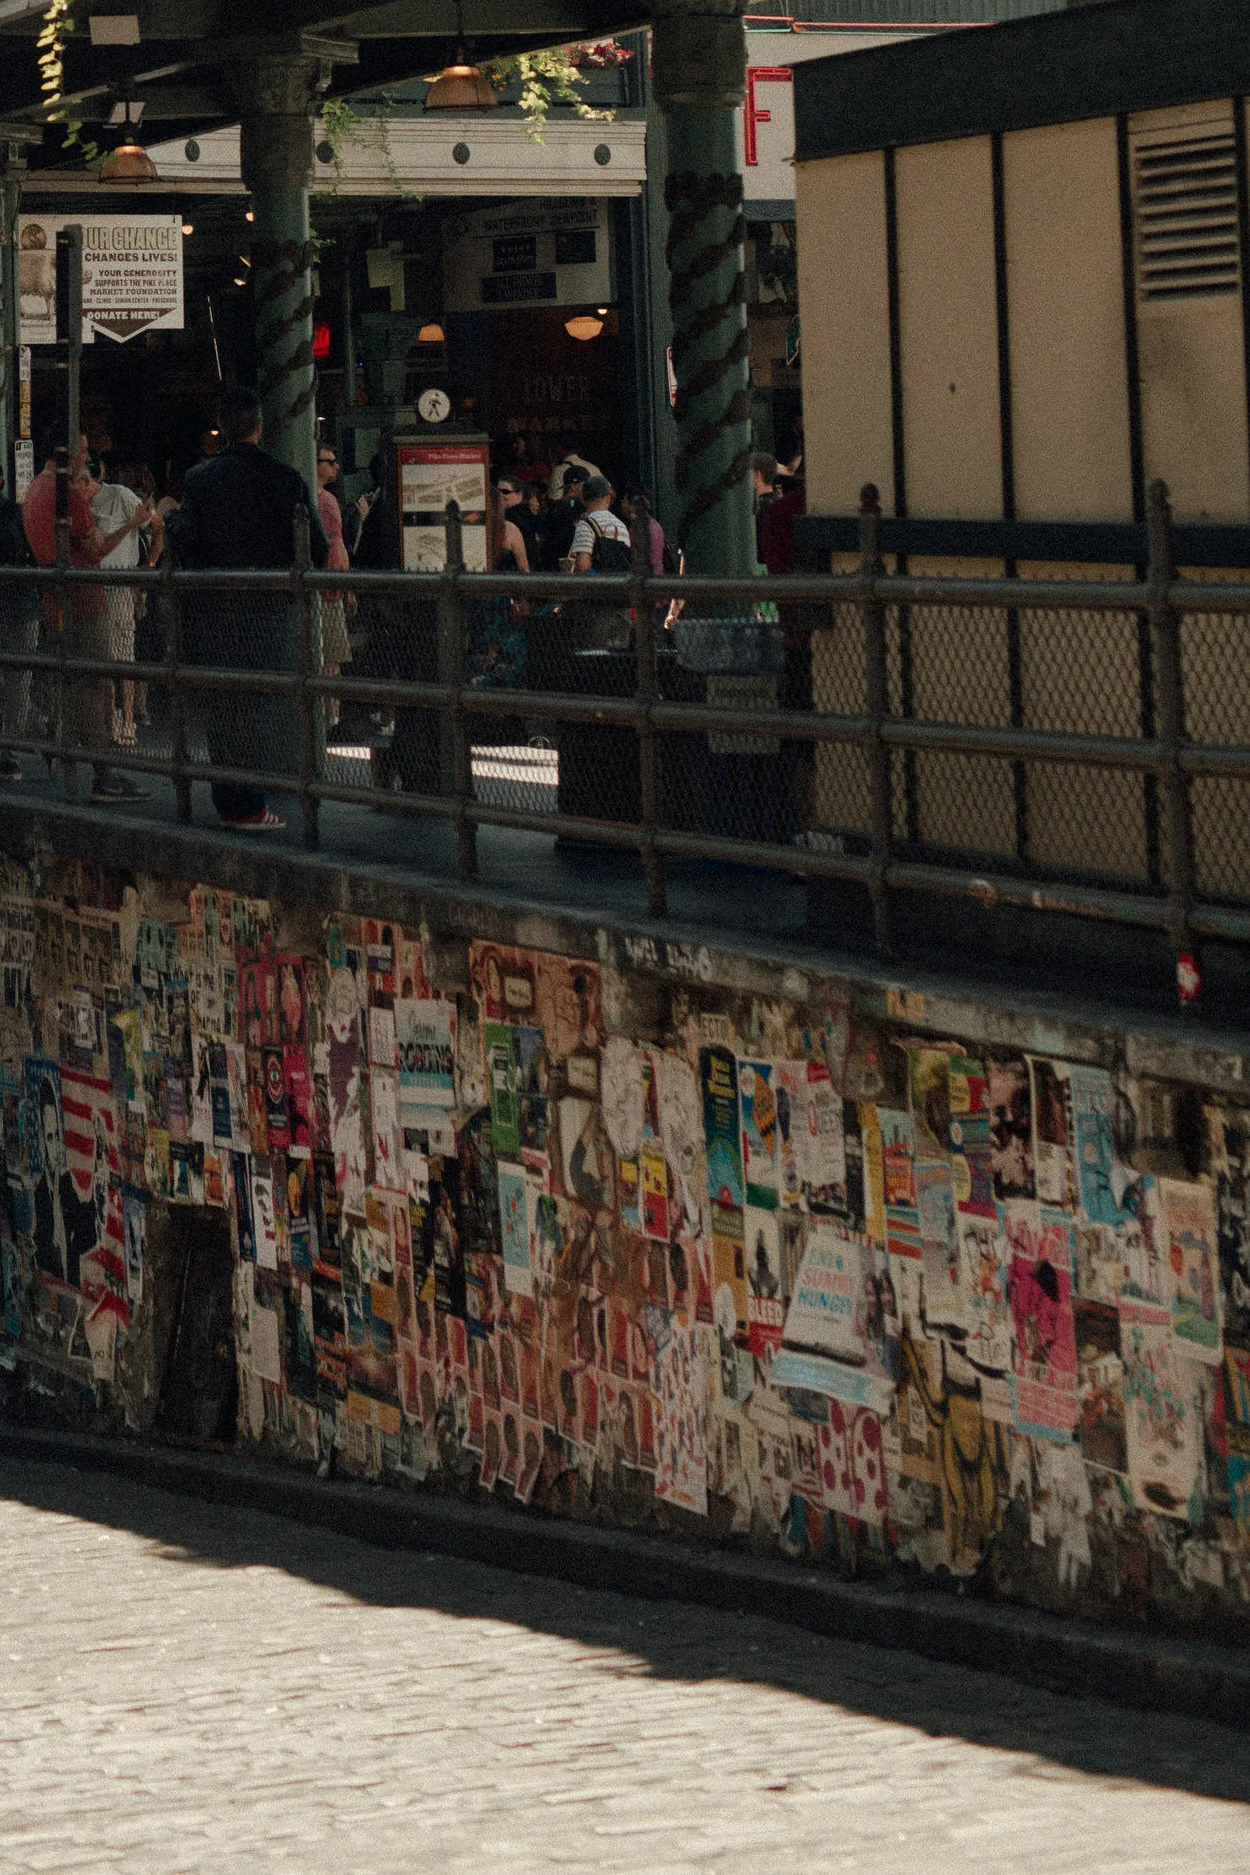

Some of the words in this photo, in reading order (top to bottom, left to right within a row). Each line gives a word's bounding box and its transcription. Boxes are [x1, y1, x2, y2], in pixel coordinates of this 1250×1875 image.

[112, 226, 178, 251] CHANGE
[84, 252, 139, 263] CHANGES
[141, 252, 178, 263] LIVES!
[86, 311, 129, 320] DONATE
